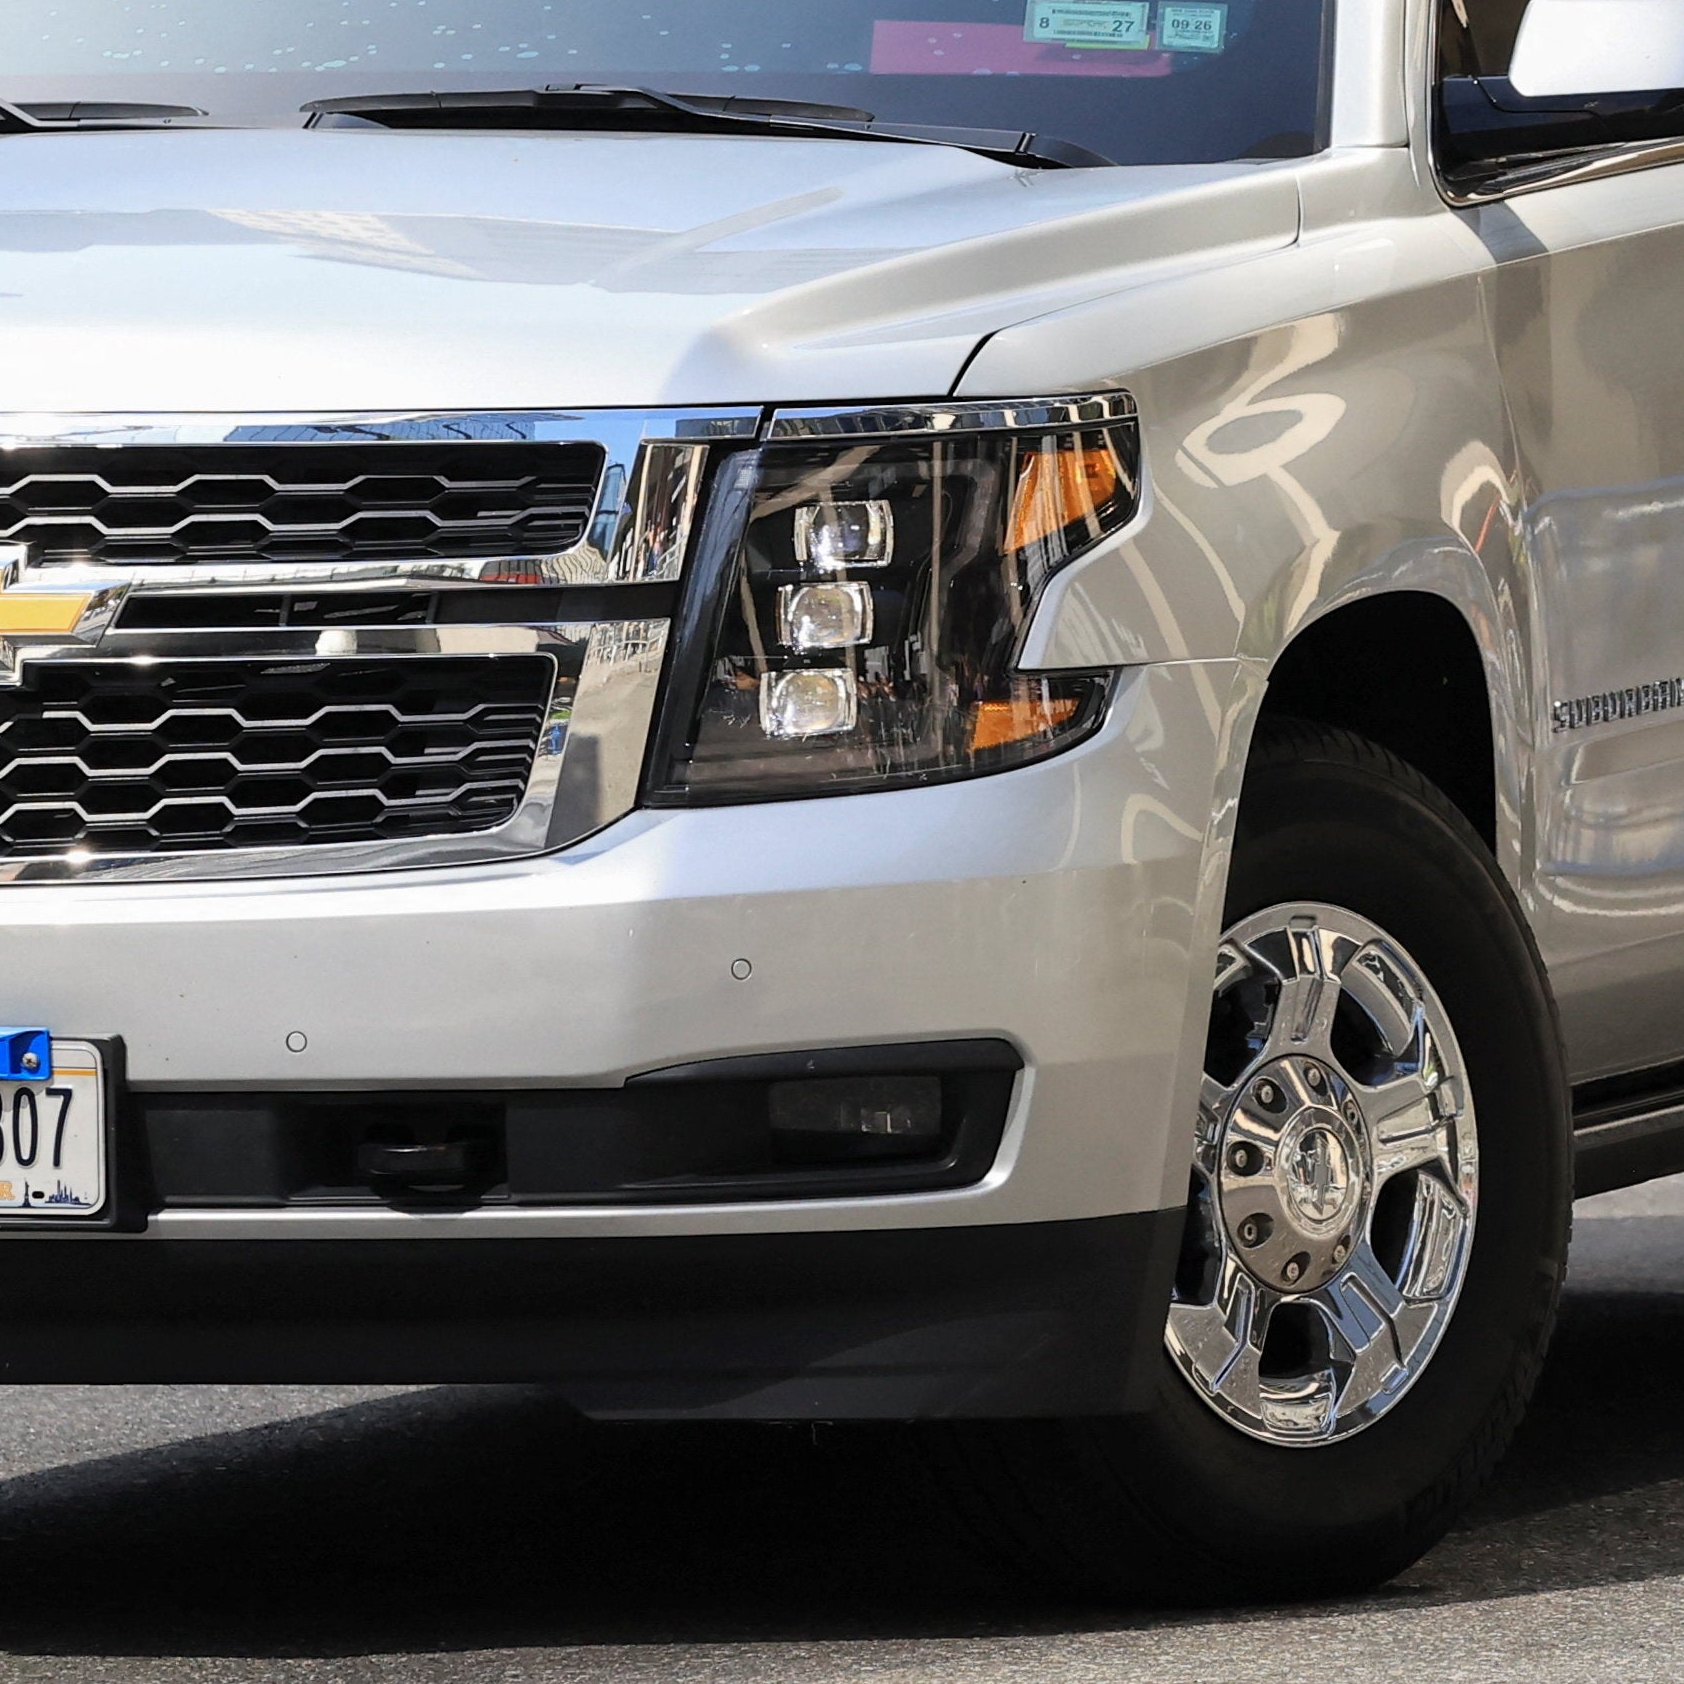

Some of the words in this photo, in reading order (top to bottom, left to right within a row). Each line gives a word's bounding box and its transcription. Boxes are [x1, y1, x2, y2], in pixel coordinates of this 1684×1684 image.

[1039, 17, 1050, 28] 8
[1112, 20, 1135, 33] 27
[1171, 19, 1190, 30] 09
[1194, 20, 1212, 31] 26
